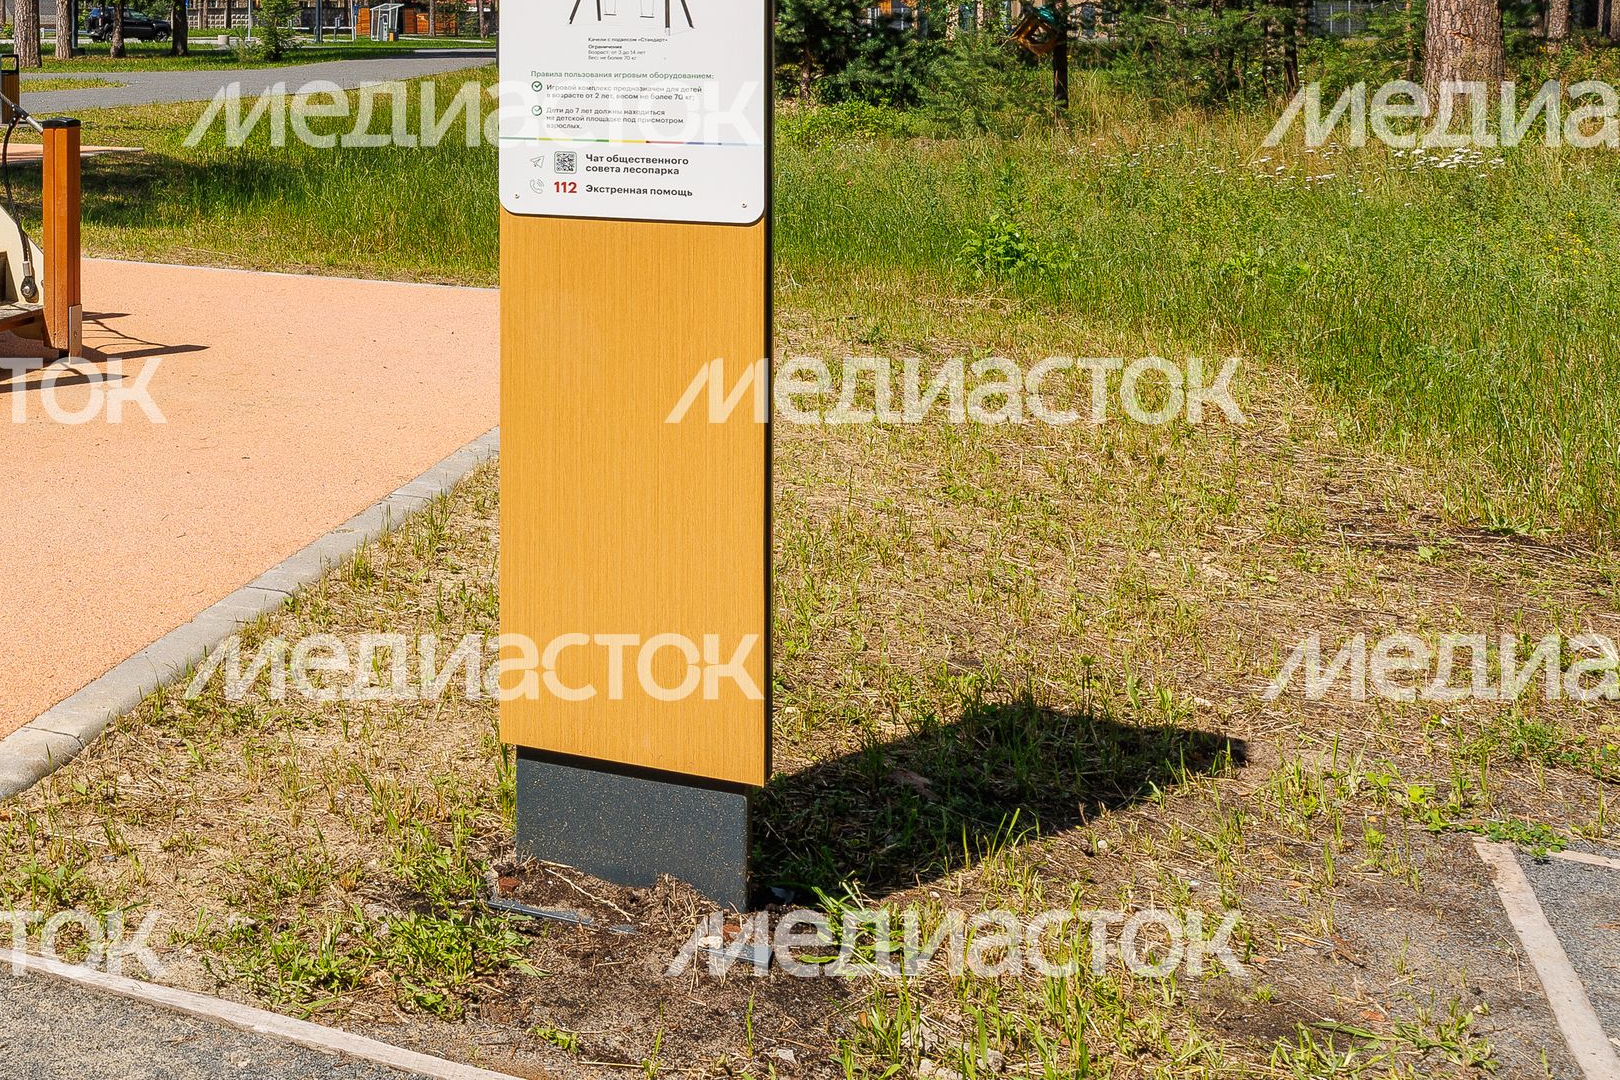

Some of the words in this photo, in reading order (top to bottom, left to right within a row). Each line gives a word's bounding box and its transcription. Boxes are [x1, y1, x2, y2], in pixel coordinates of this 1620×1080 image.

[586, 154, 604, 163] Чат
[606, 155, 689, 165] общественного
[585, 165, 621, 173] совета
[623, 166, 679, 176] лесопарка
[554, 181, 577, 194] 112
[585, 184, 648, 195] Экстренная
[650, 188, 693, 197] помощь
